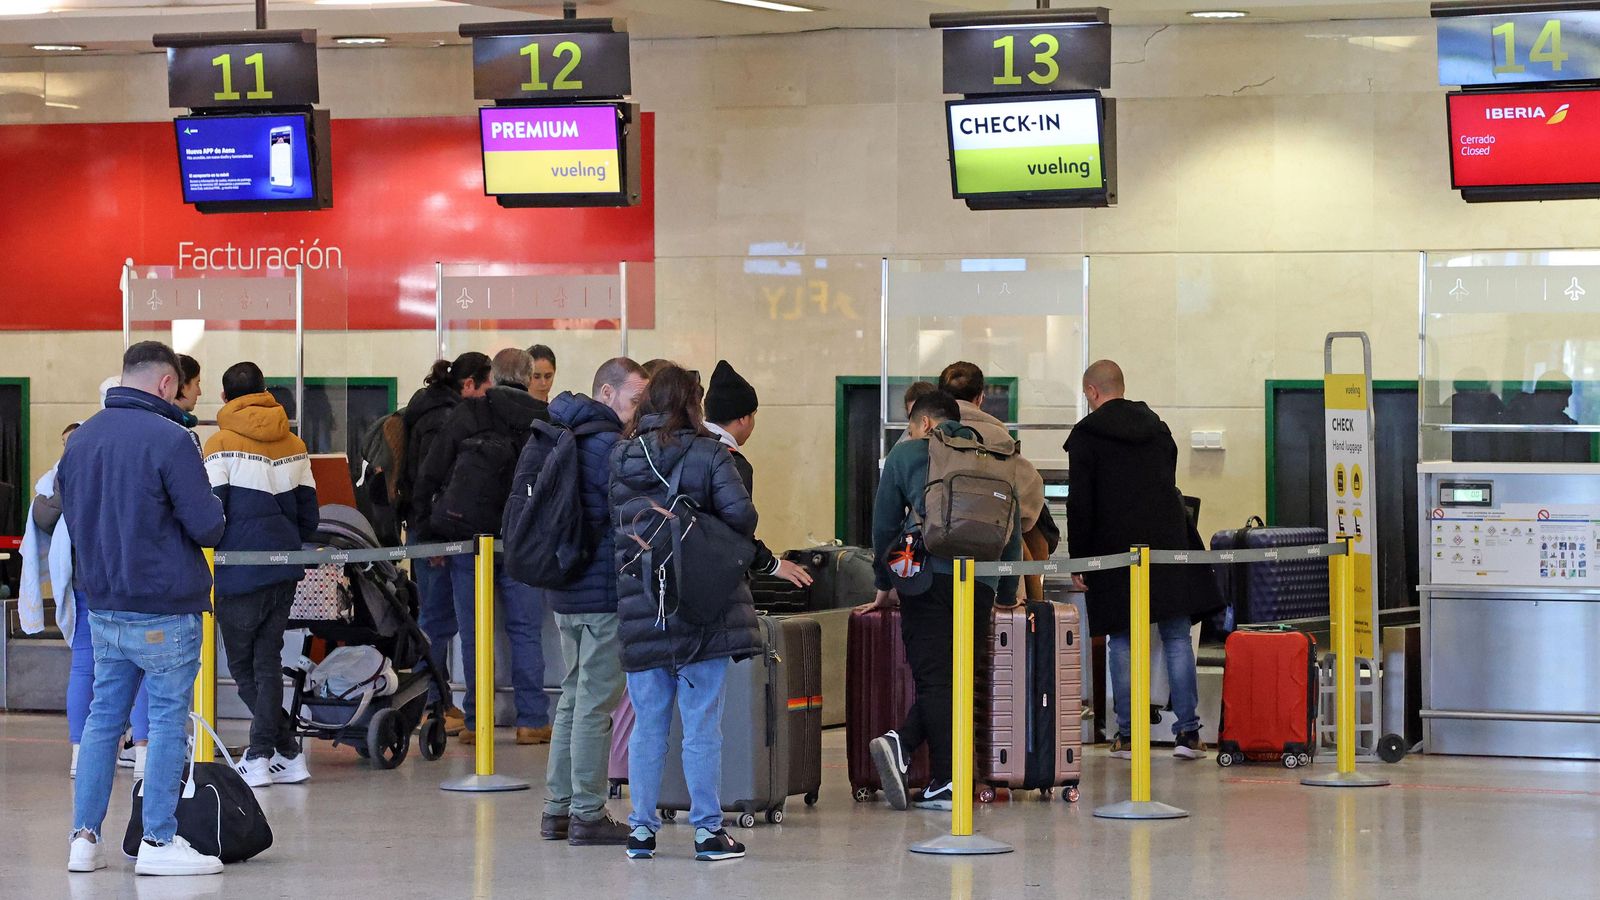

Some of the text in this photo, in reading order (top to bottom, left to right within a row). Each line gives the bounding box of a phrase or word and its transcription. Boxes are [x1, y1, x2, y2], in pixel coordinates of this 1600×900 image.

[1492, 19, 1569, 74] 14
[518, 41, 583, 91] 12
[993, 33, 1060, 85] 13
[211, 53, 274, 100] 11
[1485, 106, 1546, 119] IBERIA
[490, 121, 579, 140] PREMIUM
[959, 113, 1061, 134] CHECK-IN
[1460, 134, 1496, 145] Cerrado
[1461, 146, 1490, 156] Closed
[551, 161, 606, 182] vueling
[1027, 157, 1091, 178] vueling
[178, 238, 342, 271] Facturación
[1332, 418, 1354, 431] CHECK
[1333, 440, 1363, 454] Hand luggage
[270, 552, 288, 564] vueling
[331, 551, 348, 562] vueling
[390, 548, 407, 559] vueling
